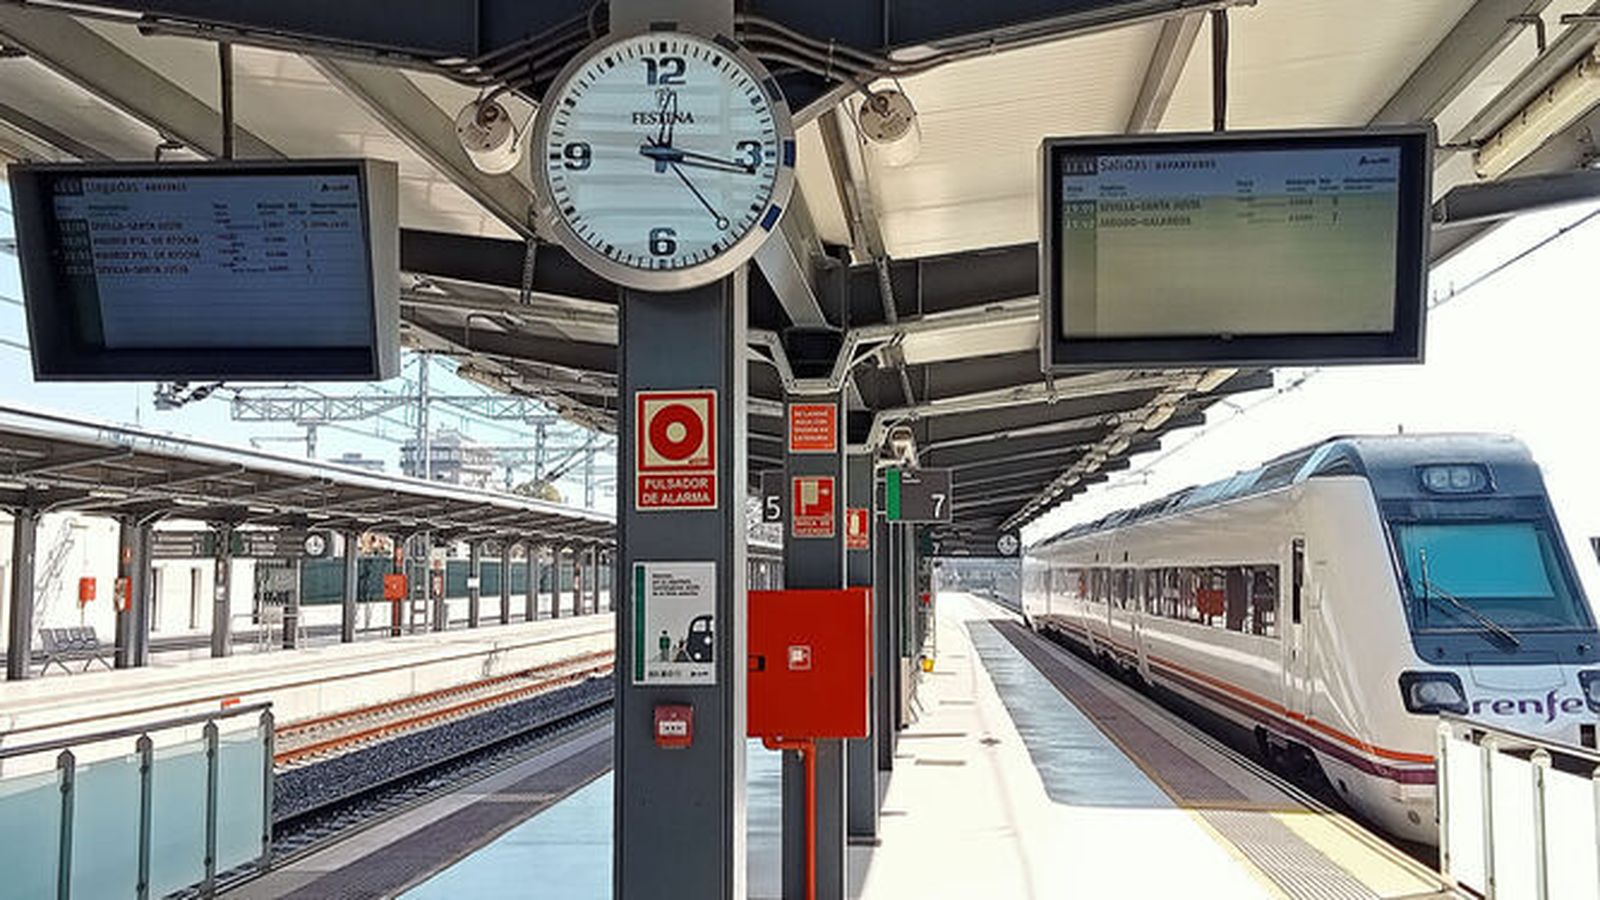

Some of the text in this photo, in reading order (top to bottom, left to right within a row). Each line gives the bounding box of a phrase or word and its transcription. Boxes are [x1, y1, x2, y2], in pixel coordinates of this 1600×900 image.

[641, 57, 687, 86] 12
[632, 112, 694, 125] FESTINA
[563, 142, 592, 171] 9
[735, 140, 763, 170] 3
[1100, 157, 1147, 172] Salidas
[648, 227, 677, 257] 6
[645, 477, 708, 491] PULSADOR
[642, 491, 711, 505] DE ALARMA
[767, 495, 780, 519] 5
[930, 493, 947, 518] 7
[1472, 689, 1583, 724] renfe
